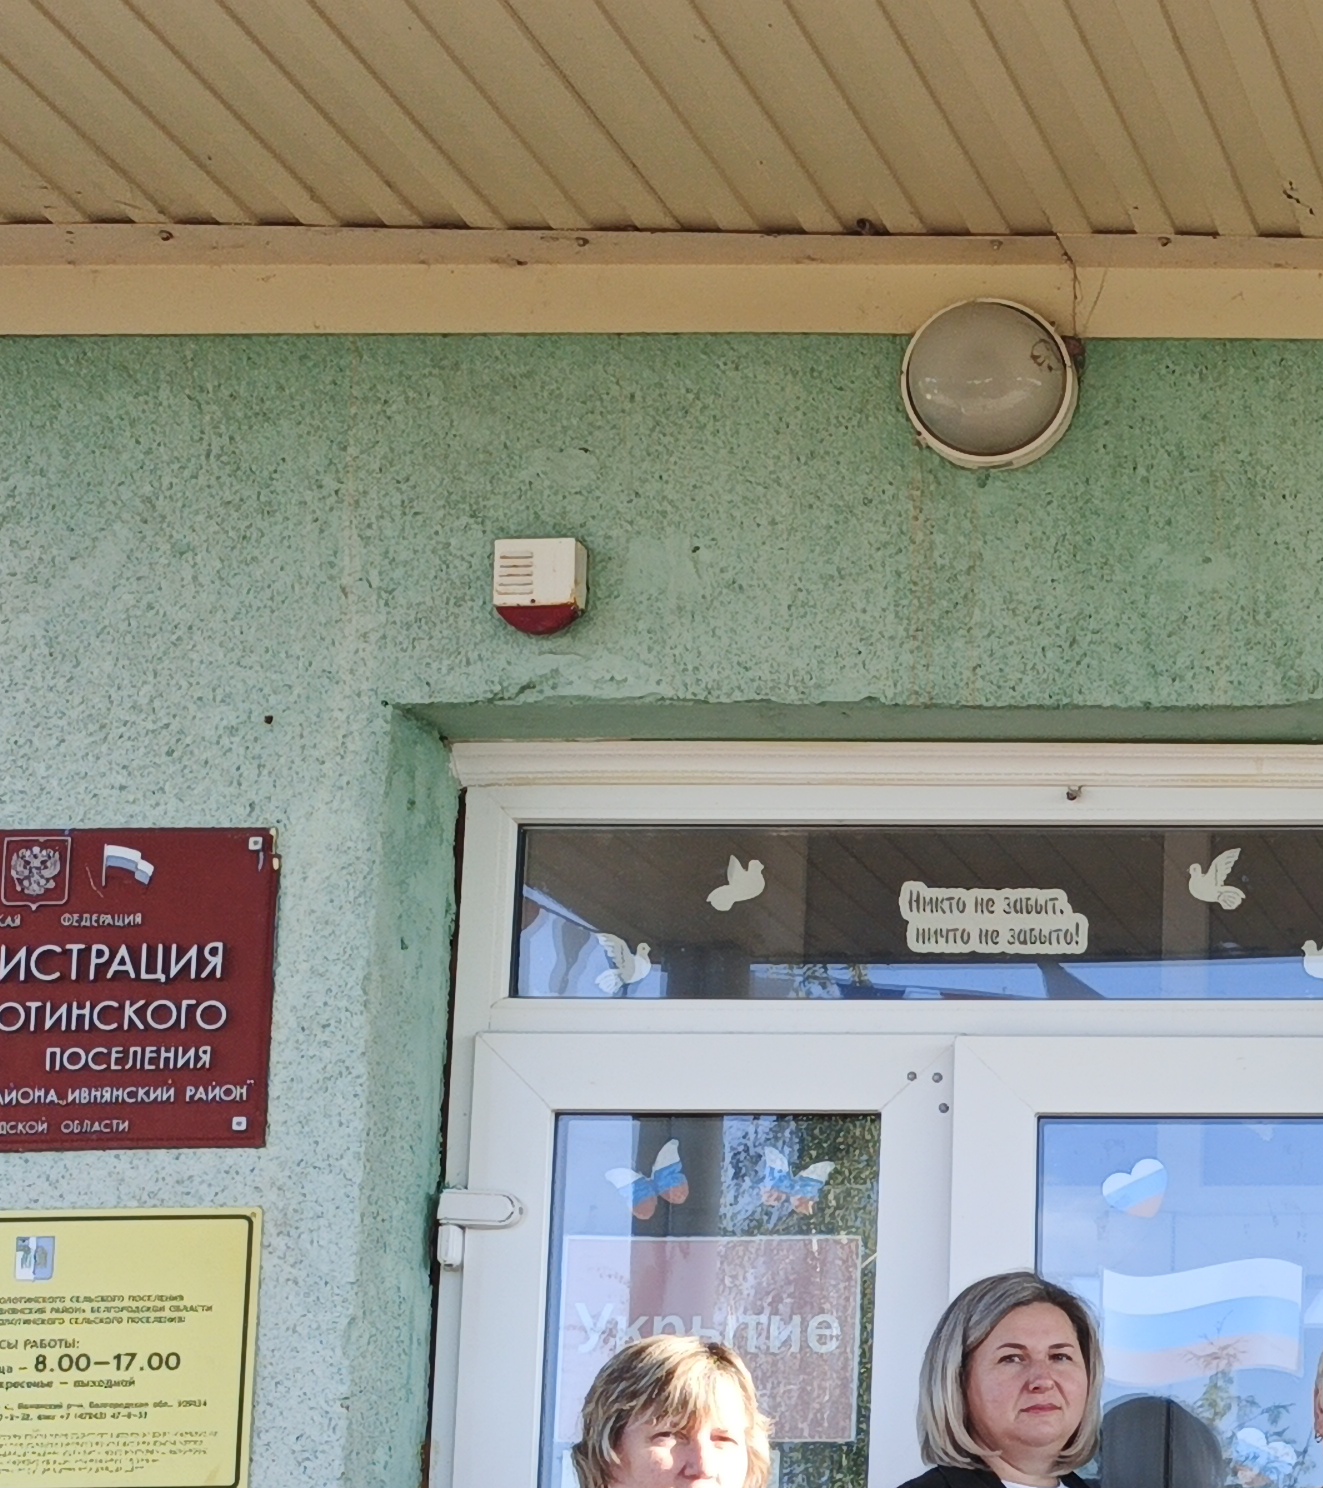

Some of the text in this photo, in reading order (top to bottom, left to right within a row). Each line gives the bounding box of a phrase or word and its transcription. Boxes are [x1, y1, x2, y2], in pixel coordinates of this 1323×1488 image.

[61, 913, 141, 927] ФЕДЕРАЦИЯ
[0, 942, 223, 982] ИСТРАЦИЯ
[46, 1044, 211, 1071] ПОСЕЛЕНИЯ
[61, 1120, 128, 1136] ОБЛАСТИ
